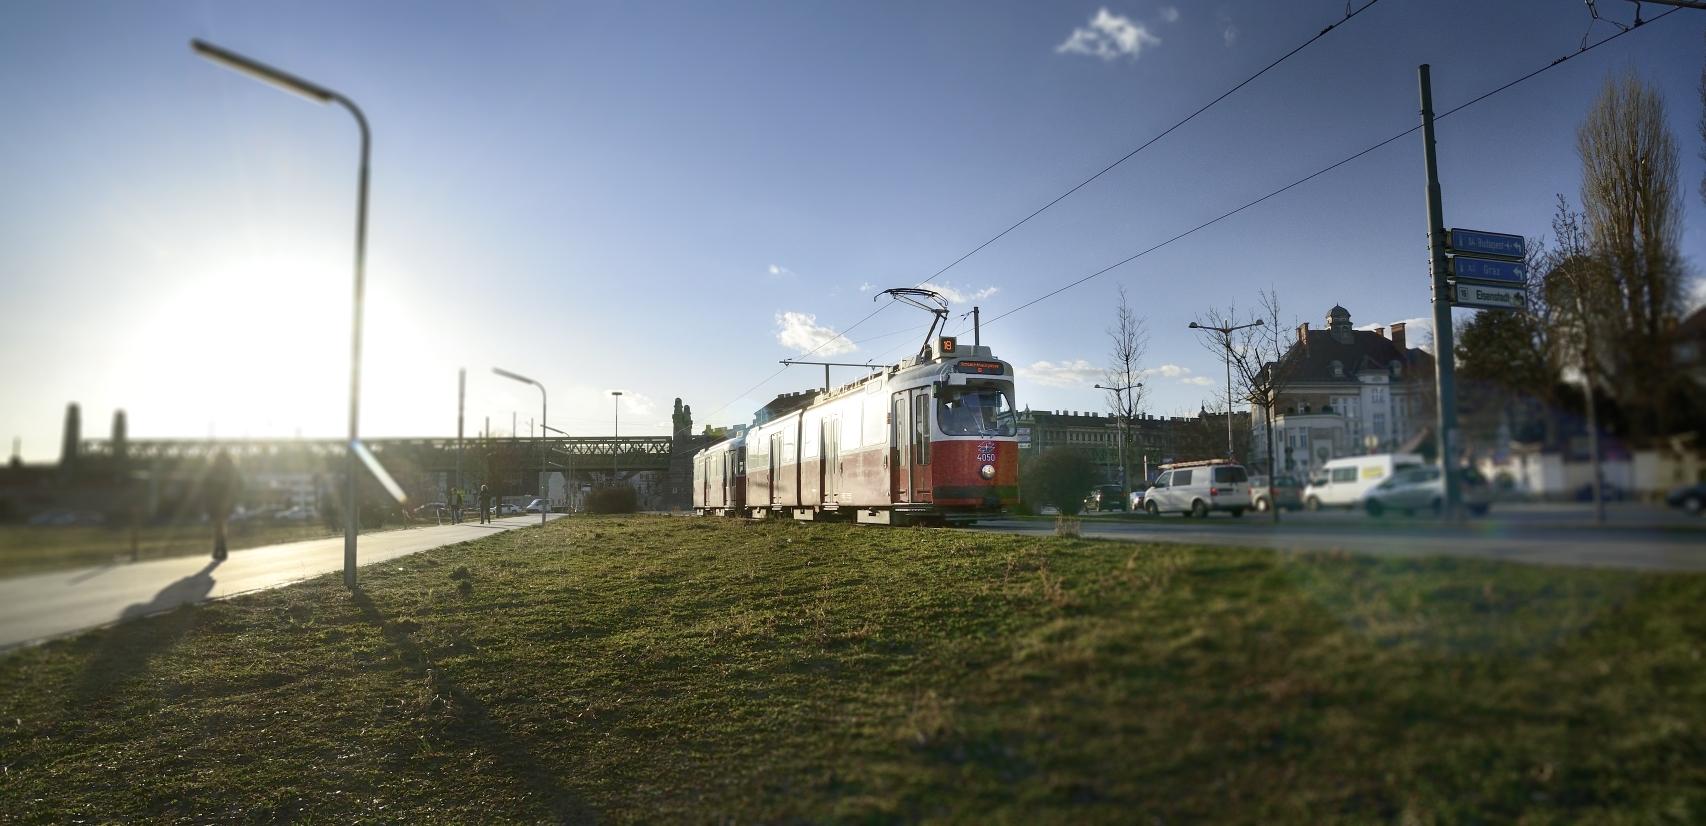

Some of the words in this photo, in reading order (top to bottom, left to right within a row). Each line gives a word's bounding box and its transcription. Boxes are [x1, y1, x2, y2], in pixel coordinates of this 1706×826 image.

[1478, 238, 1504, 251] Budapest
[1483, 264, 1501, 276] Graz
[1476, 289, 1510, 303] Eisenstadt
[943, 340, 952, 350] 18
[976, 453, 996, 462] 4050
